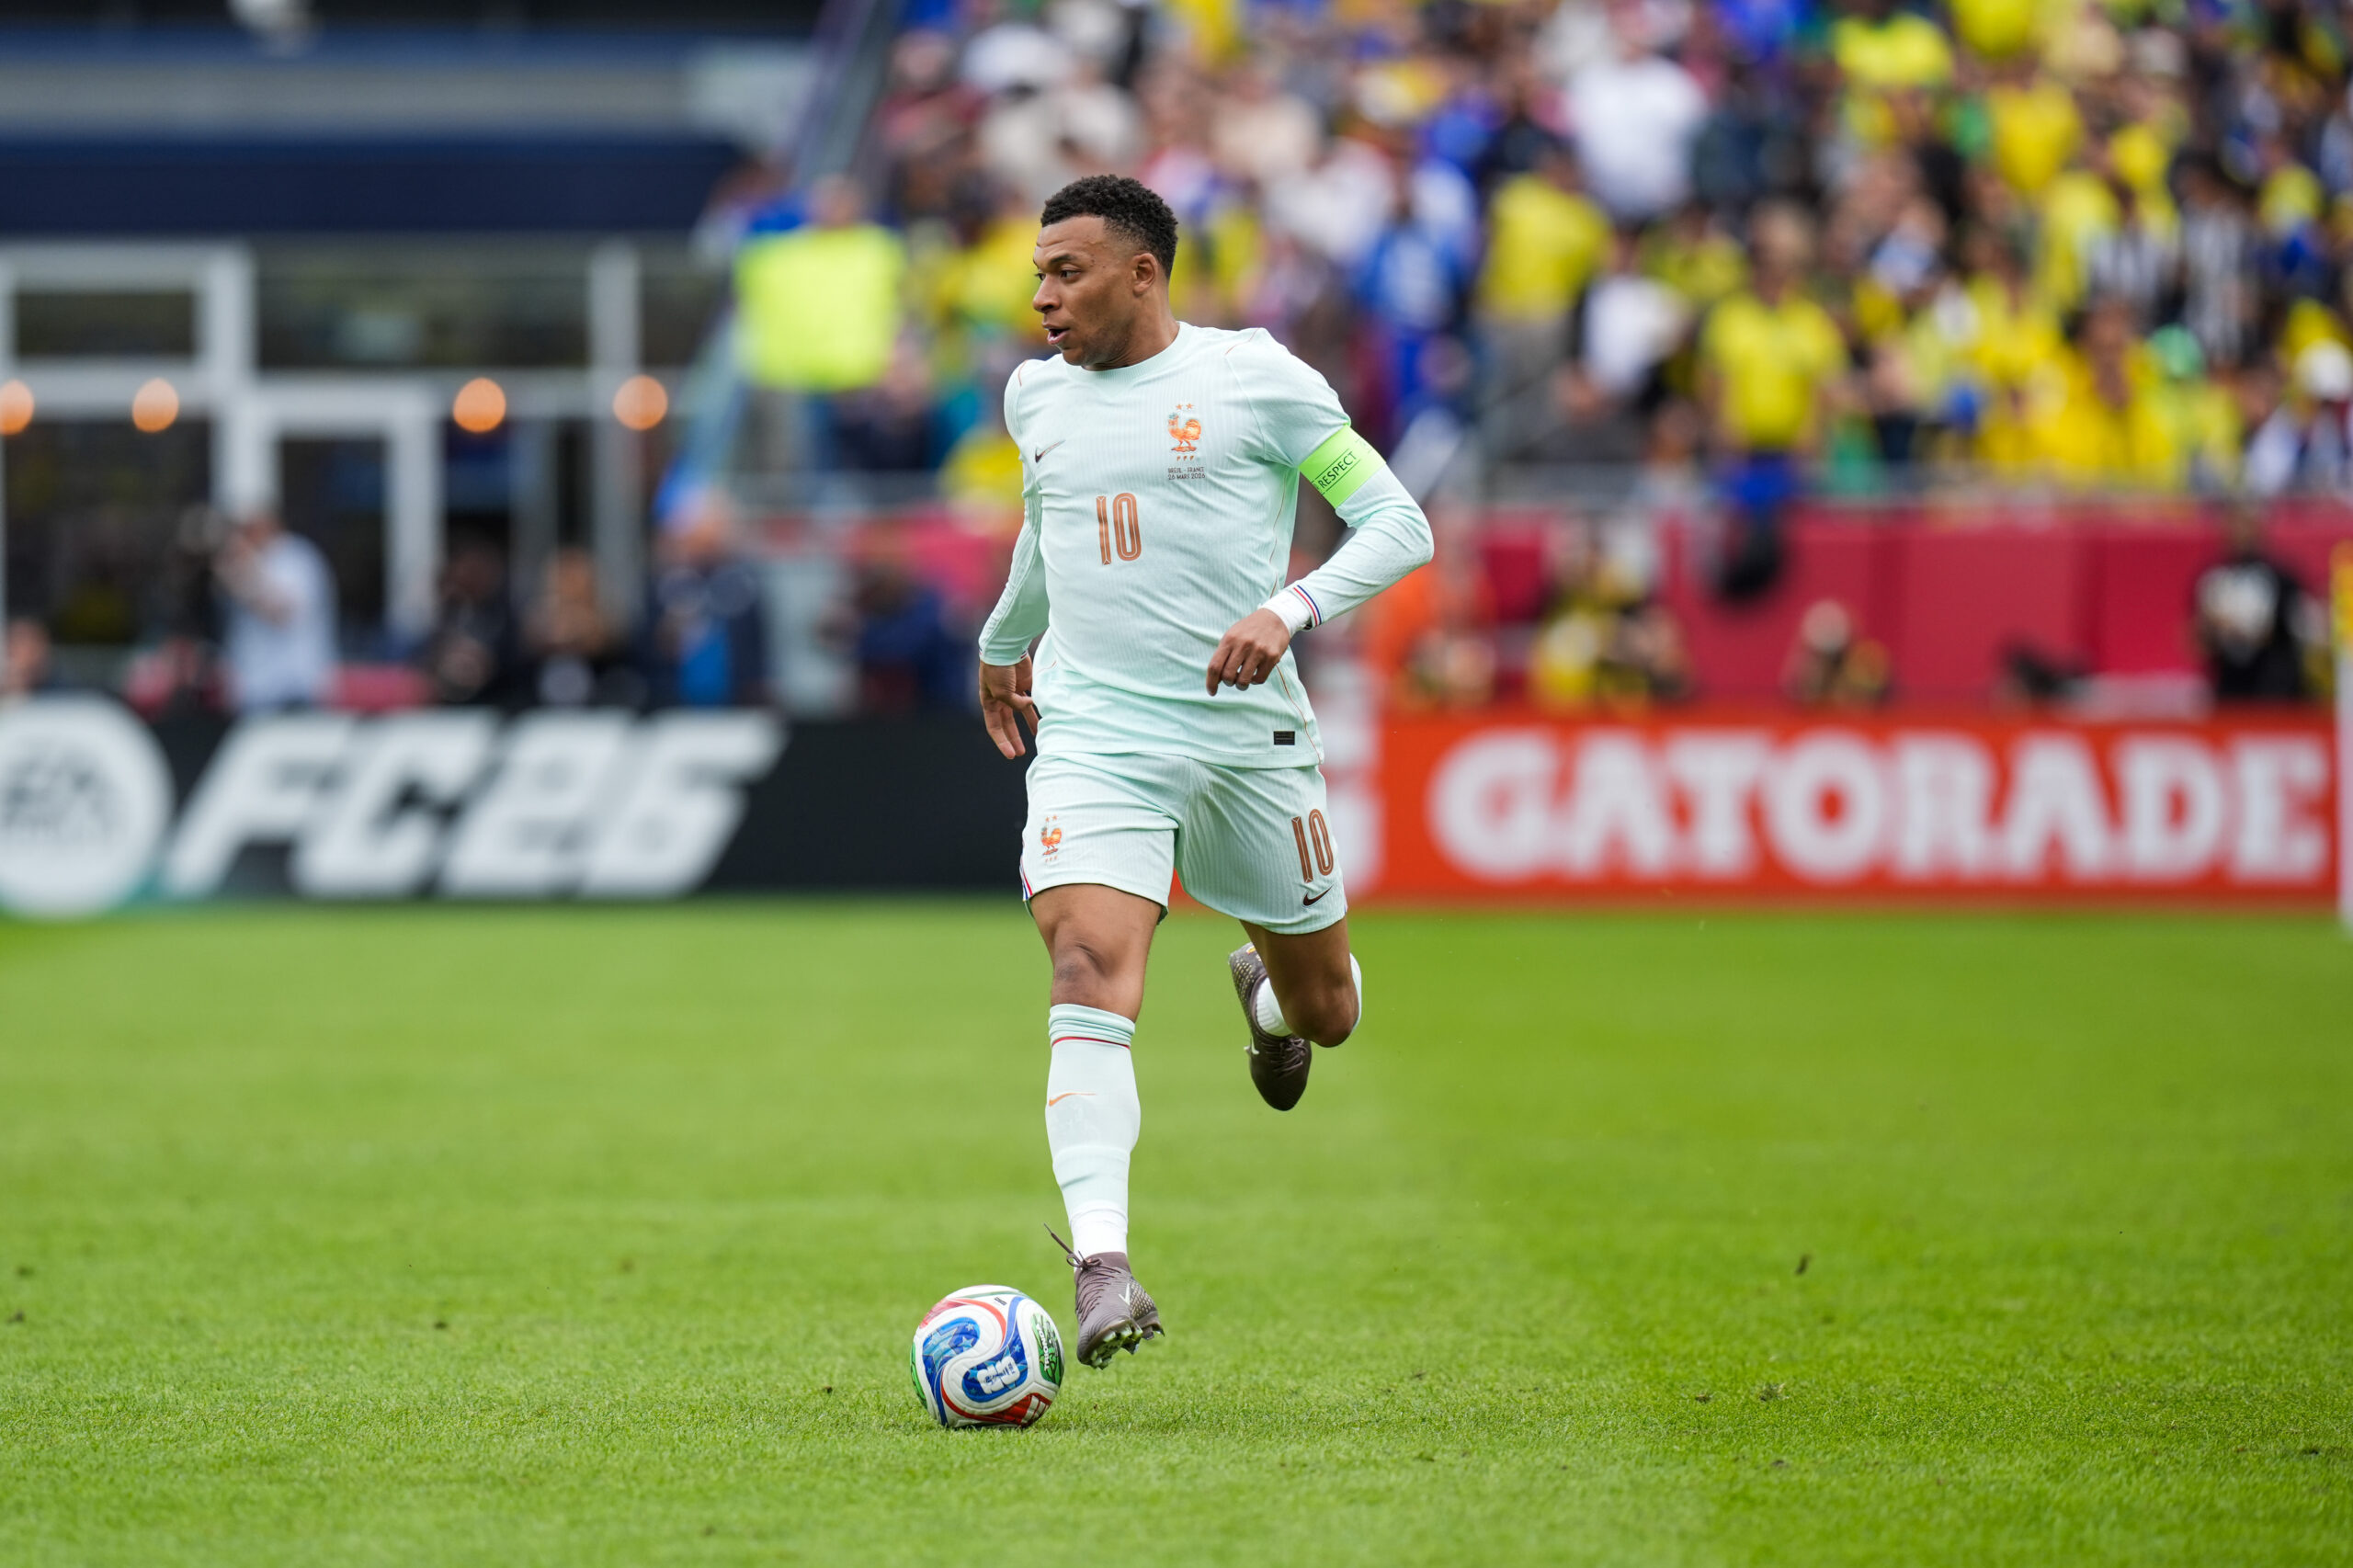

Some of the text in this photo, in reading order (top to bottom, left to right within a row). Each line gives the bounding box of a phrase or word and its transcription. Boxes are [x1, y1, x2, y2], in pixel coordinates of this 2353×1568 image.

[1317, 451, 1357, 489] RESPECT
[1097, 492, 1142, 565] 10
[1428, 730, 2329, 881] GATORADE
[1291, 809, 1334, 883] 10
